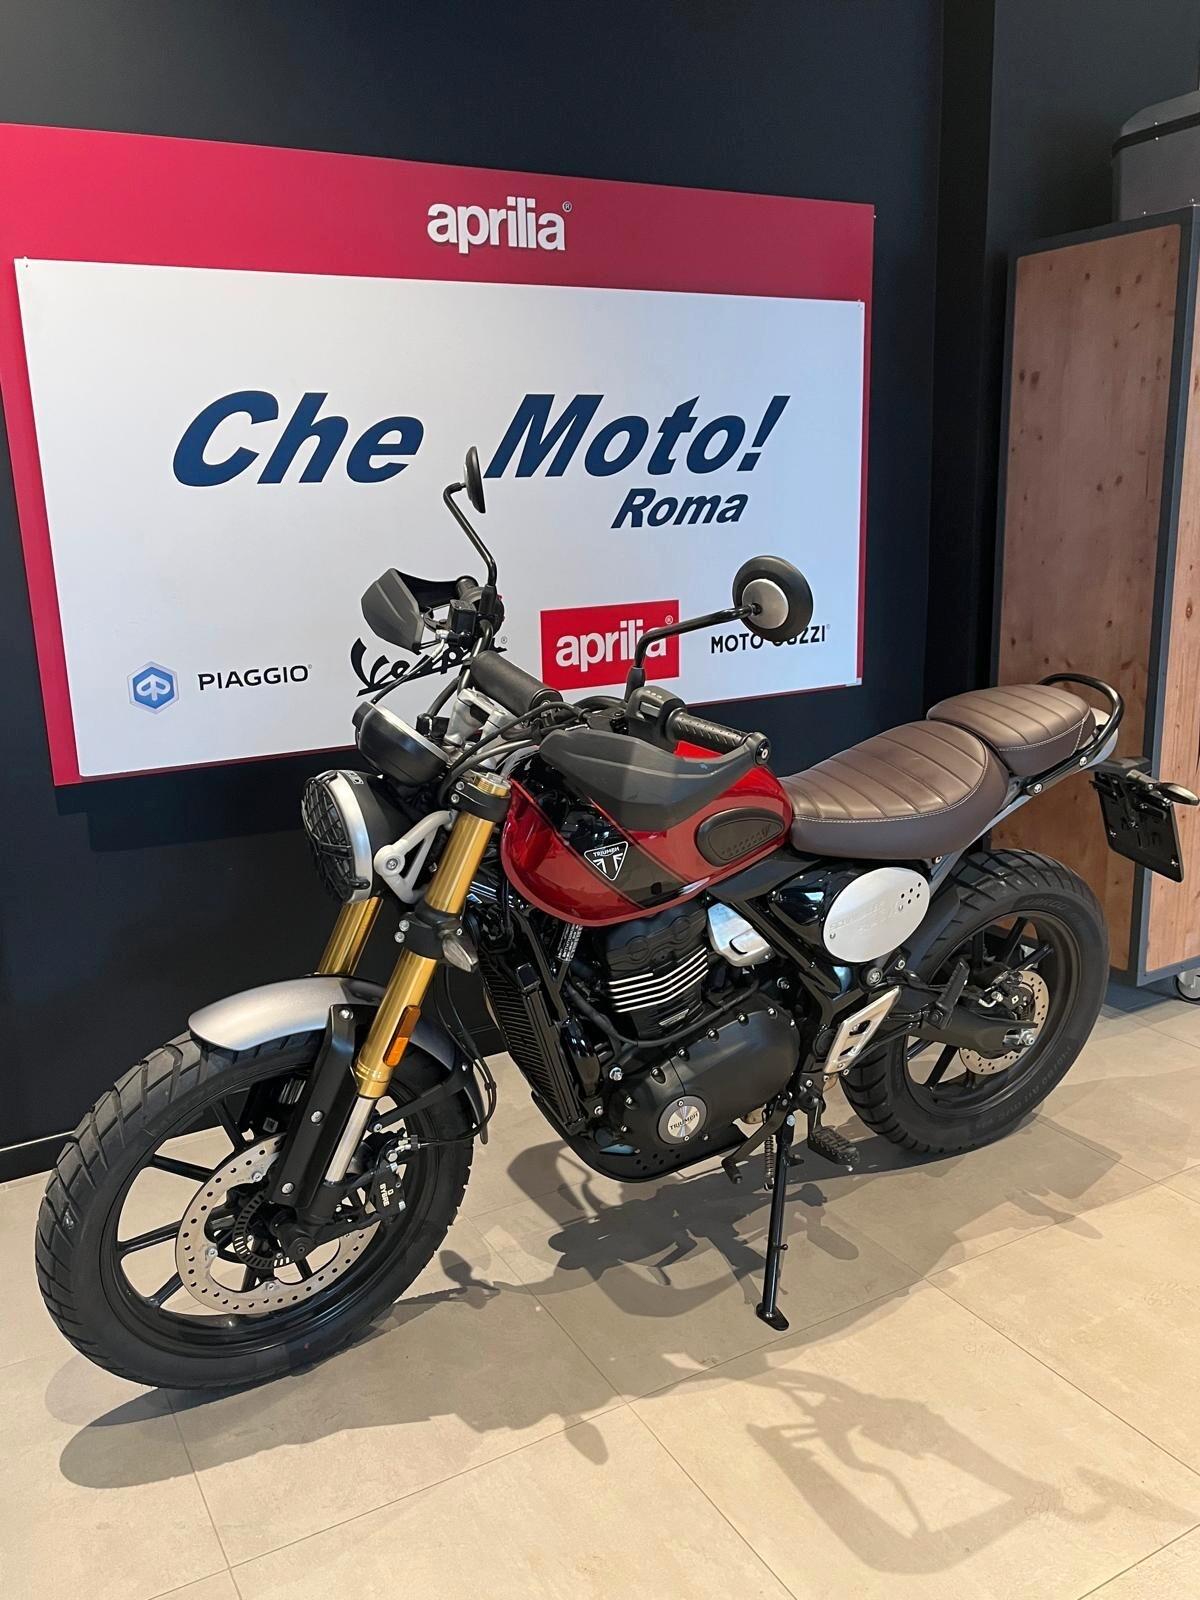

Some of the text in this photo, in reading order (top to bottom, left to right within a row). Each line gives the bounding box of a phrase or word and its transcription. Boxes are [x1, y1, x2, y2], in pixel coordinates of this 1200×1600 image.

[427, 196, 566, 254] aprilia
[173, 390, 790, 487] Che Moto!
[611, 488, 748, 528] Roma
[711, 625, 825, 653] MOTO ZZI
[198, 664, 309, 690] PIAGGIO
[592, 846, 620, 857] TRIUMPH
[669, 1112, 699, 1130] TRIUMPH
